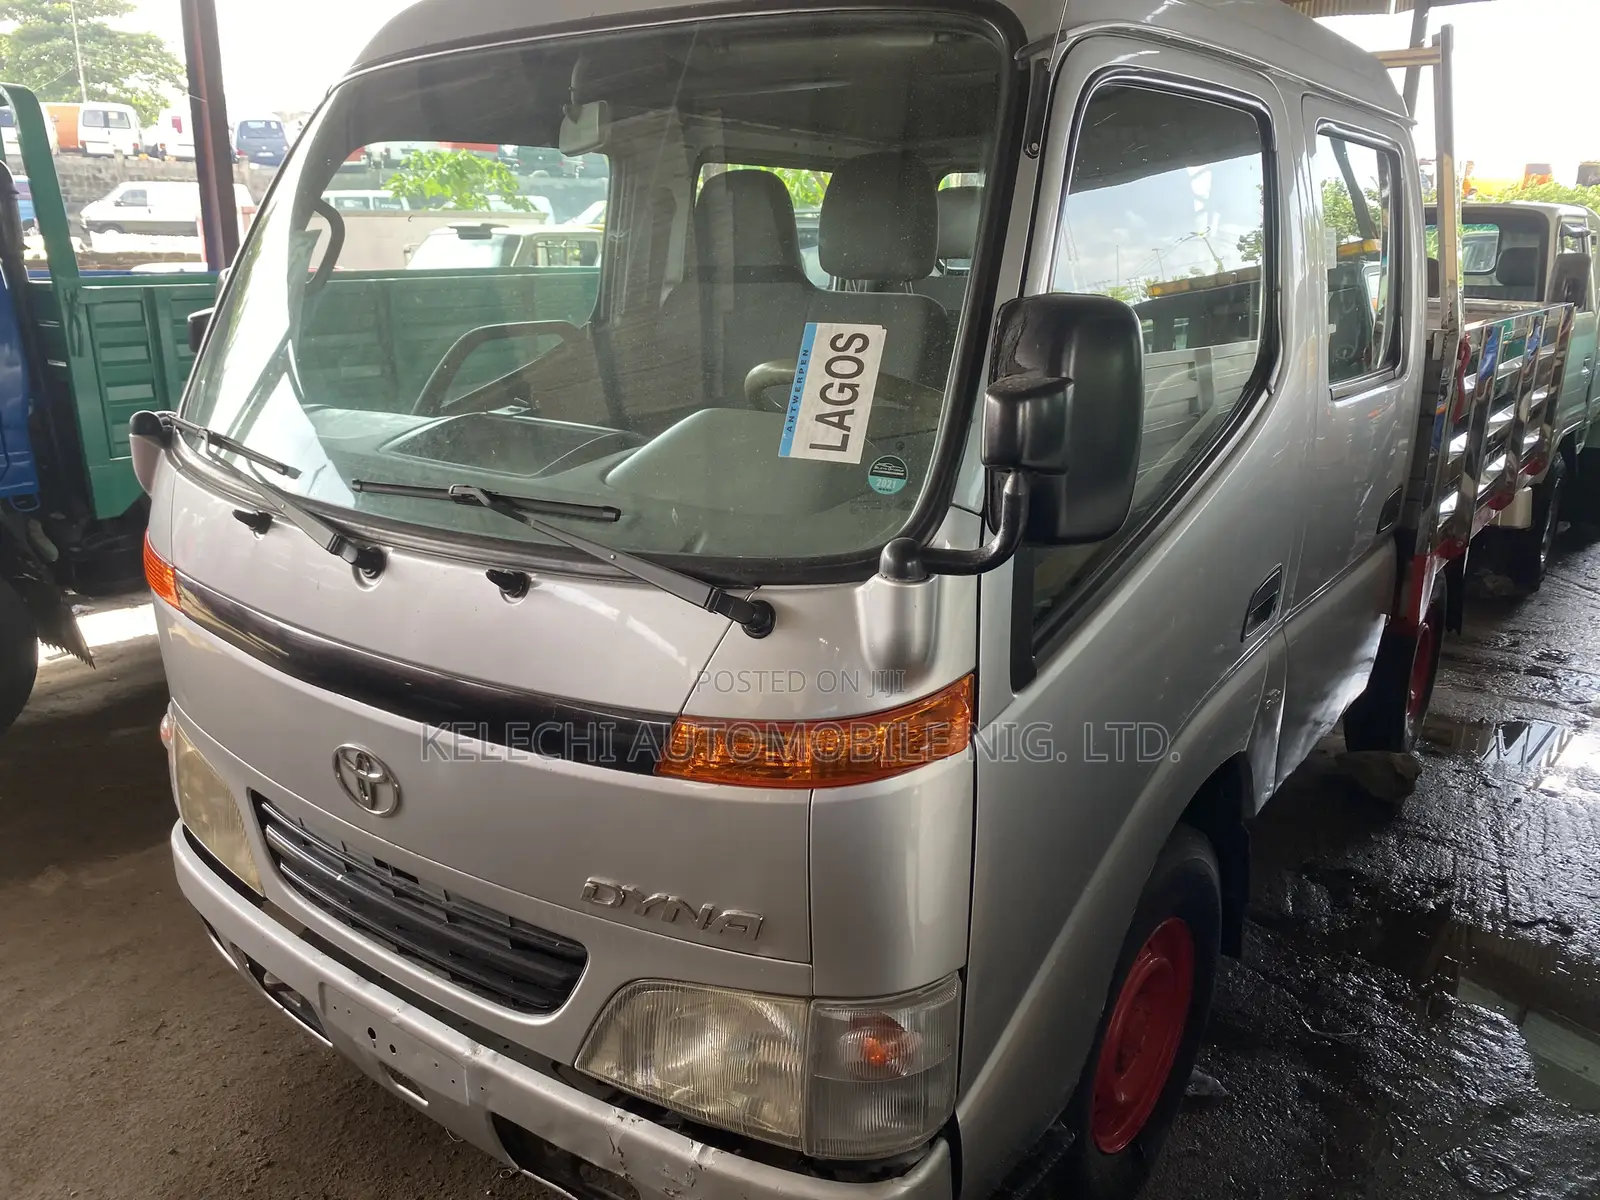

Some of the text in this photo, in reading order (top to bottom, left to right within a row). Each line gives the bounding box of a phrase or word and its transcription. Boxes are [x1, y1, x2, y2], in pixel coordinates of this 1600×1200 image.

[786, 349, 809, 432] ANTWERPEN
[809, 333, 869, 452] LAGOS
[876, 479, 897, 489] 2021
[580, 877, 765, 940] DYNA
